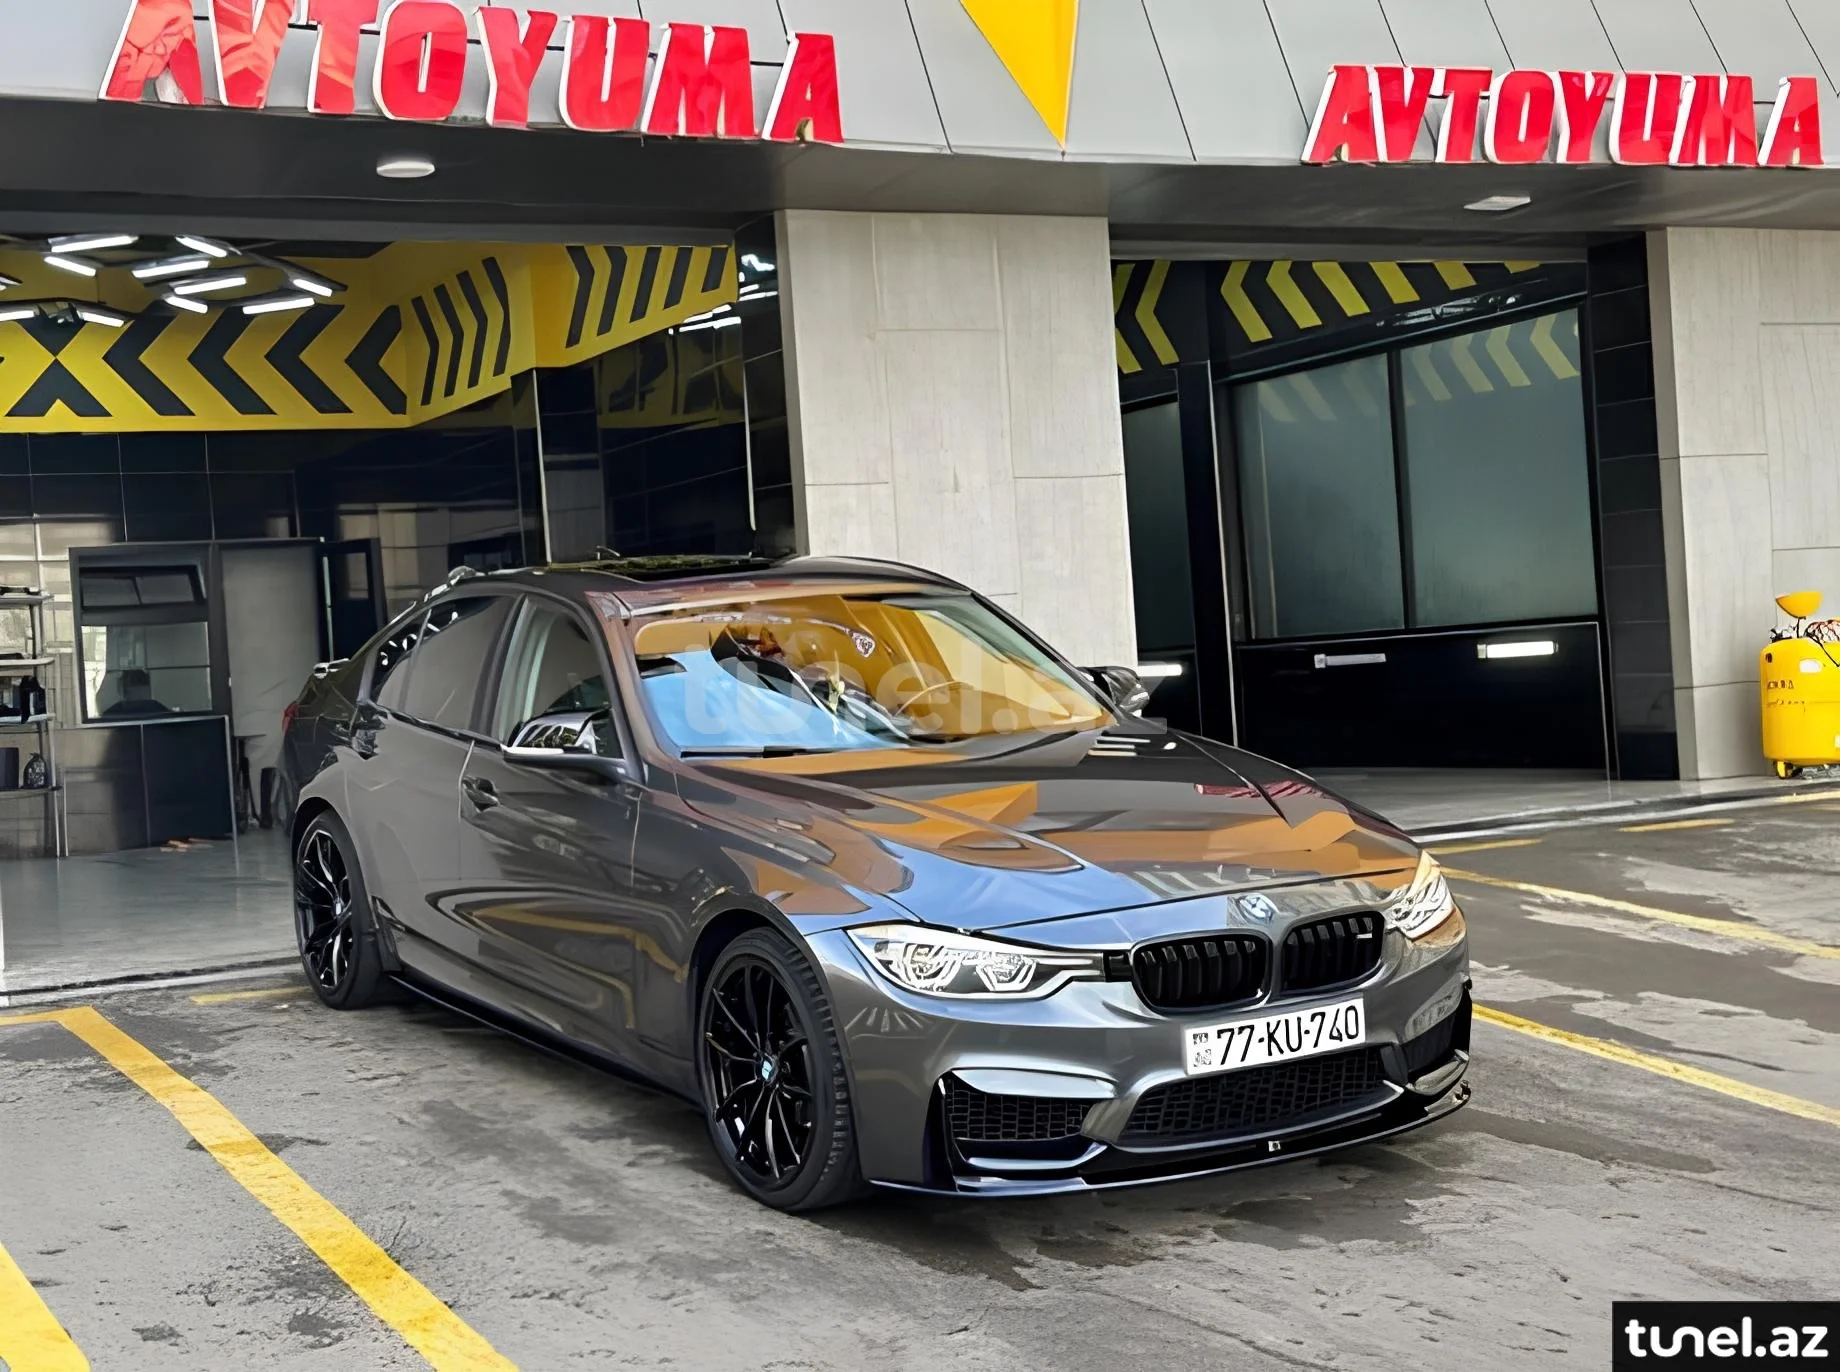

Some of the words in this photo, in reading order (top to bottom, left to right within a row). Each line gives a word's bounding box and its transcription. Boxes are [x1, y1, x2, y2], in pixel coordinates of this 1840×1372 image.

[98, 0, 844, 142] AVTOYUMA
[1301, 64, 1824, 168] AVTOYUMA
[1217, 1005, 1360, 1066] 77-KU-740
